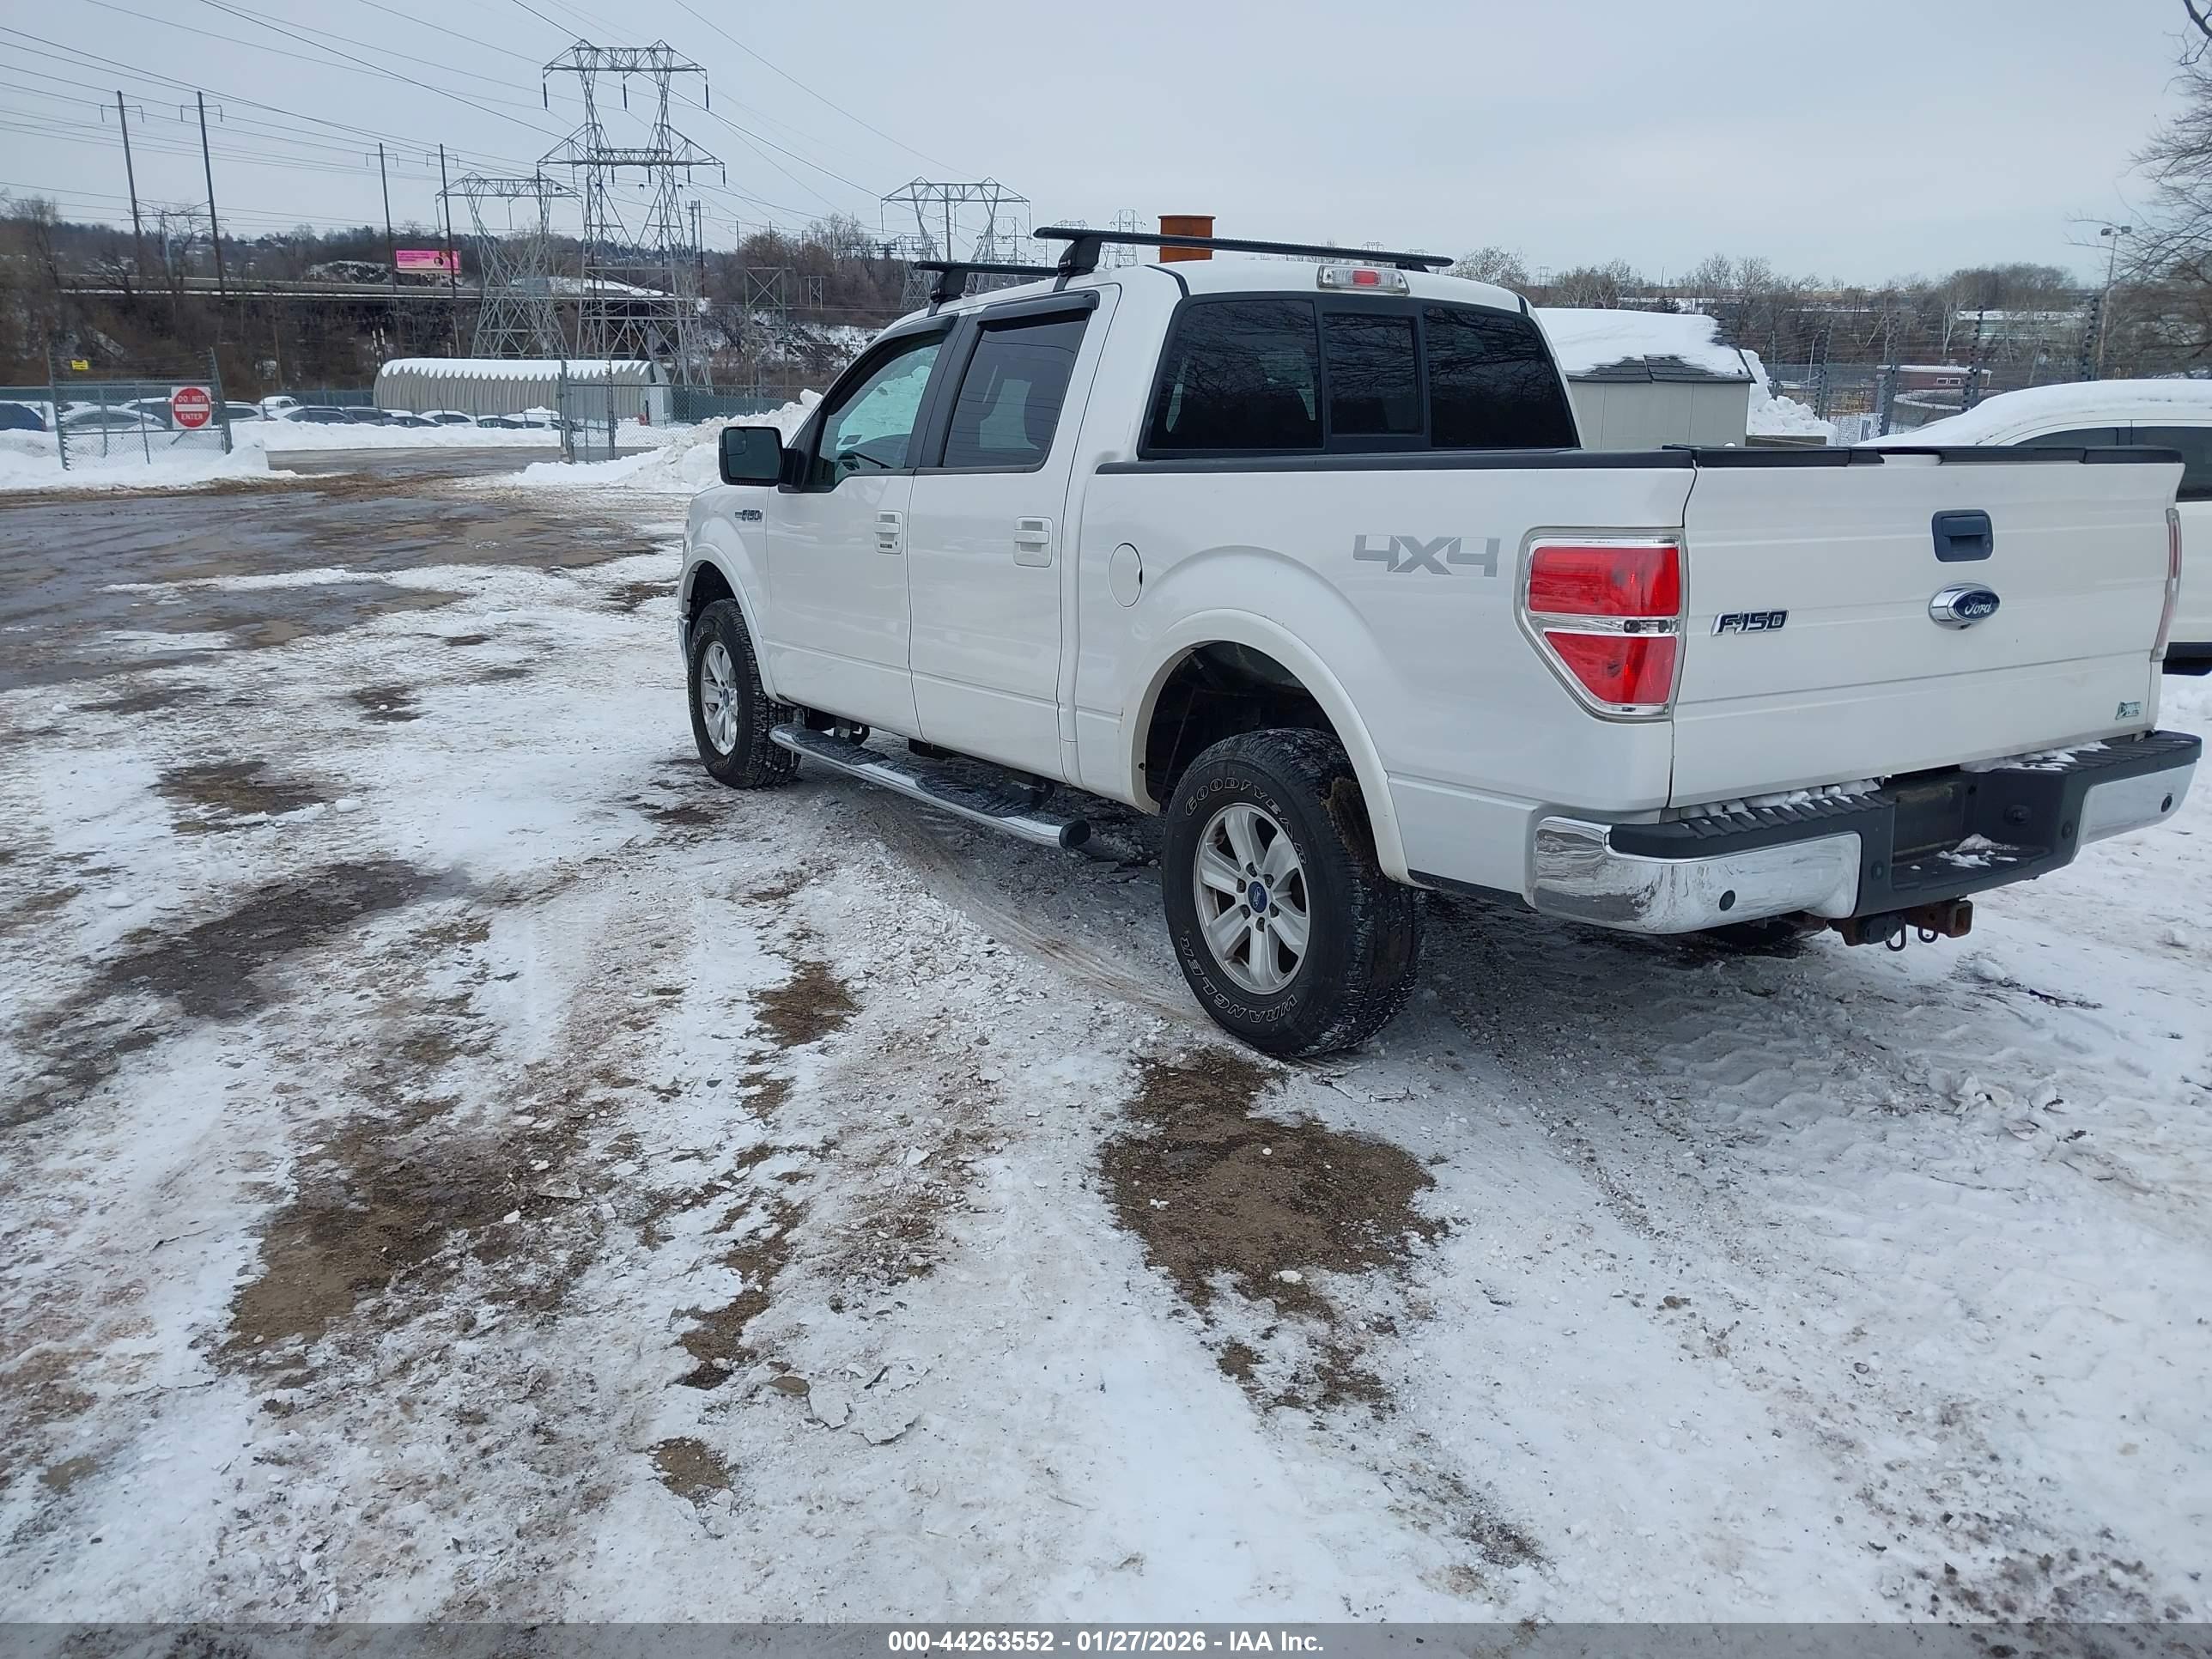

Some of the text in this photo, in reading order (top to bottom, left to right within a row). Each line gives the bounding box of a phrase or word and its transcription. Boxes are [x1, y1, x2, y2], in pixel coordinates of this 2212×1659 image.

[1964, 599, 1994, 616] Ford
[1185, 776, 1308, 865] GOODYEAR
[1180, 936, 1298, 1024] WRANGLER
